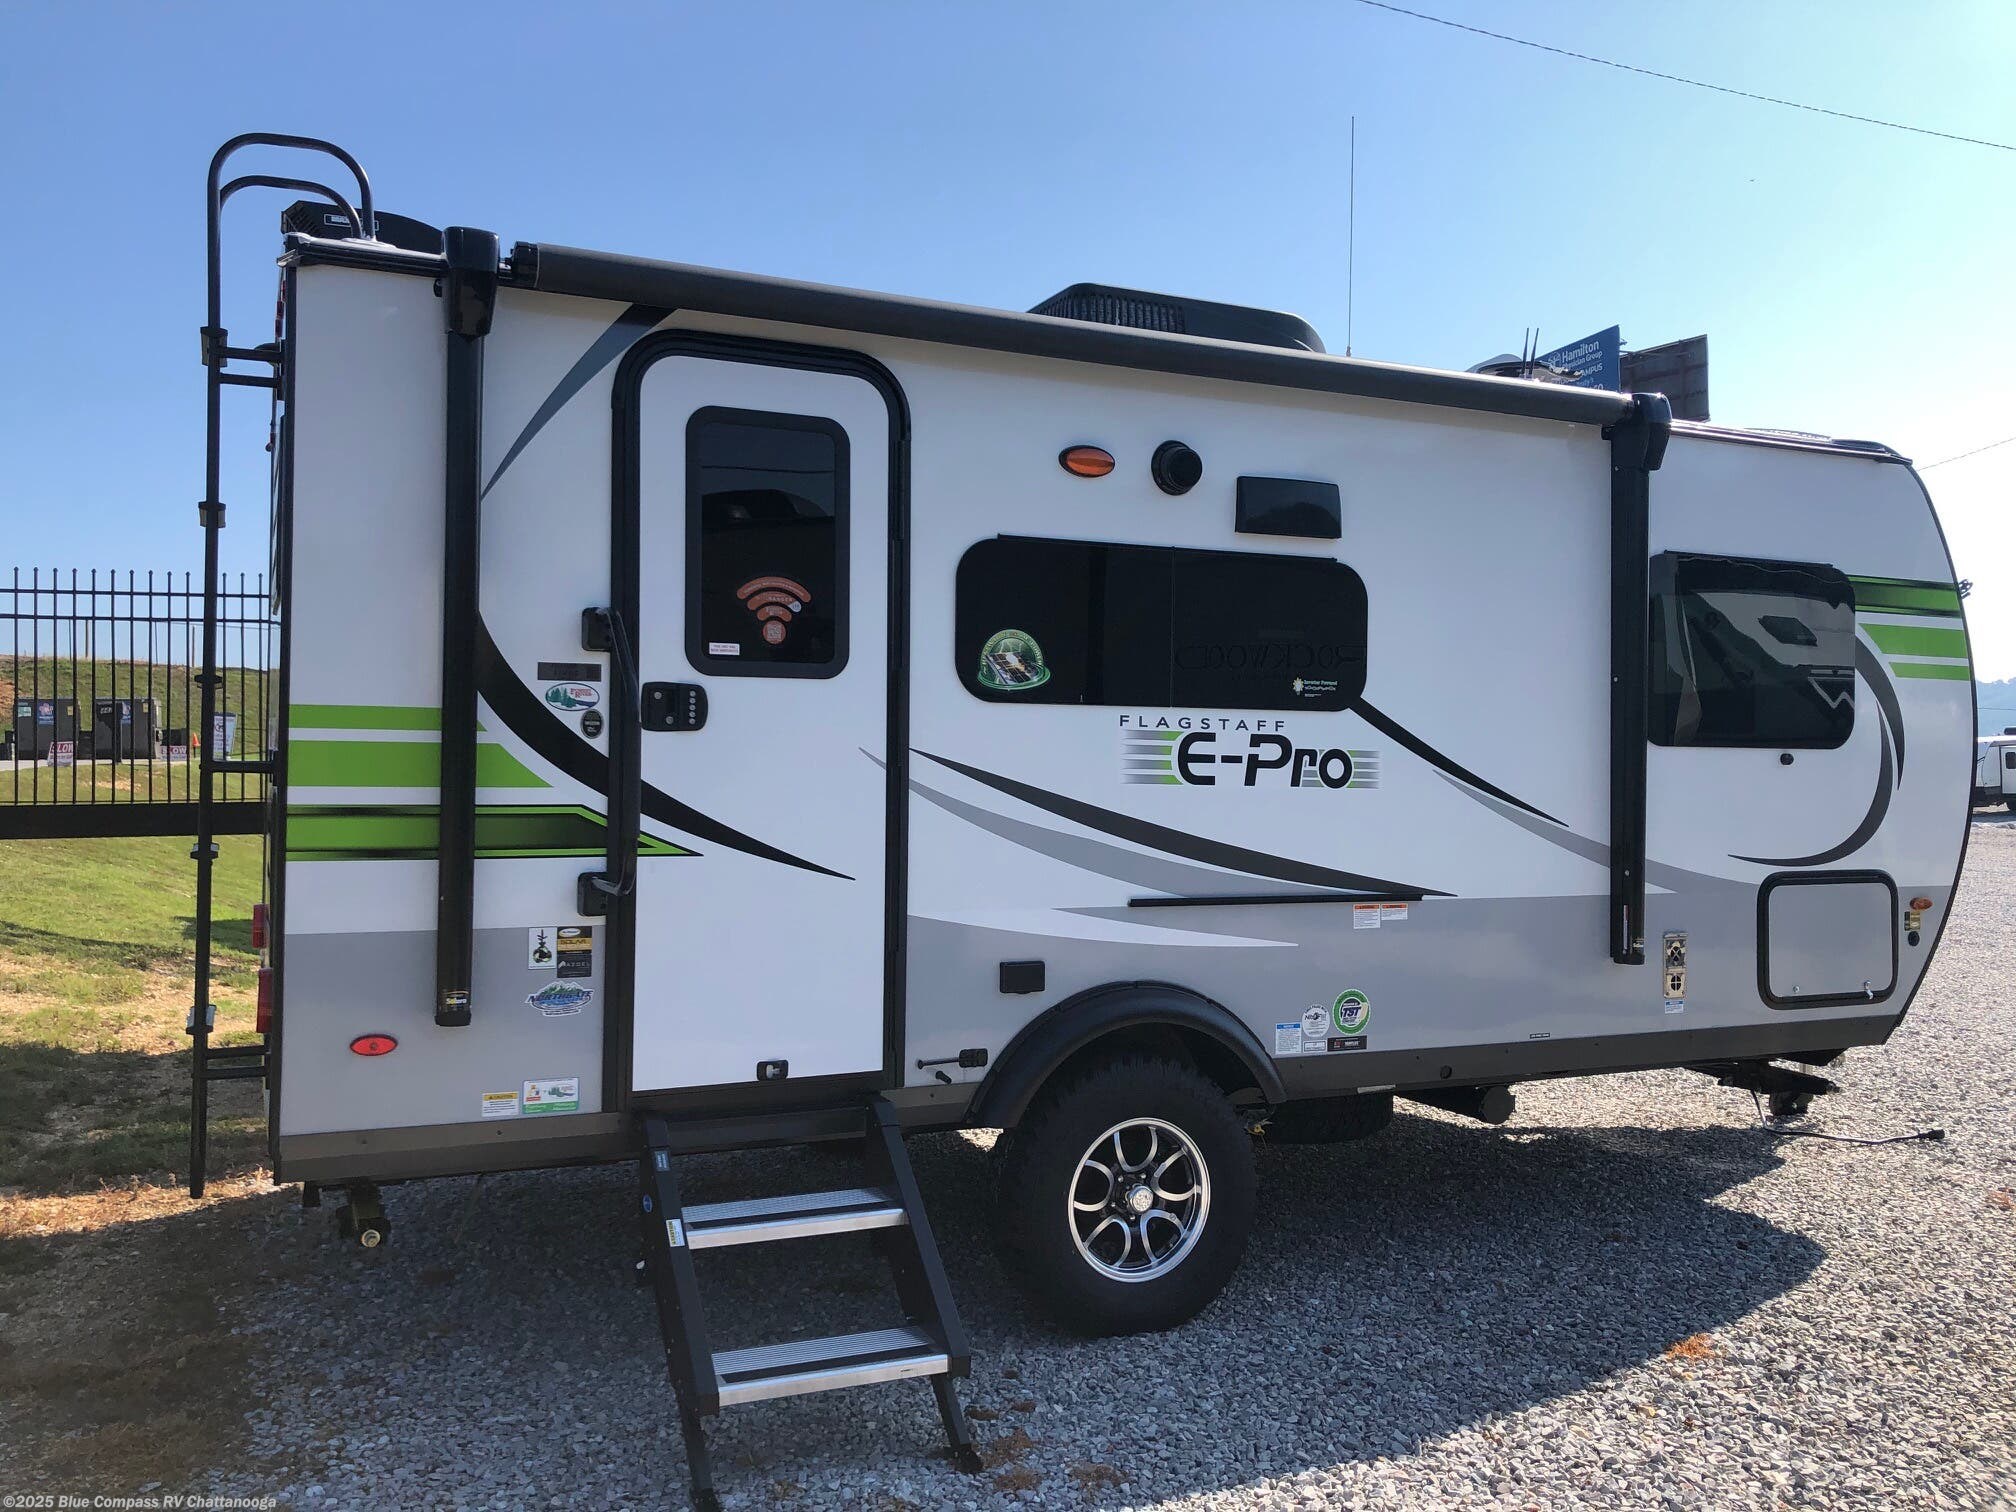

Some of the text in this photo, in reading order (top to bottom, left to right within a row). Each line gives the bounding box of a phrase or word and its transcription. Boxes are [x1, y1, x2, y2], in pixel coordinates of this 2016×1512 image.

[1562, 341, 1599, 363] Hamilton
[1585, 351, 1603, 362] Group
[1580, 363, 1603, 376] AMPUS
[1119, 715, 1286, 731] FLAGSTAFF
[1177, 731, 1353, 789] E-Pro
